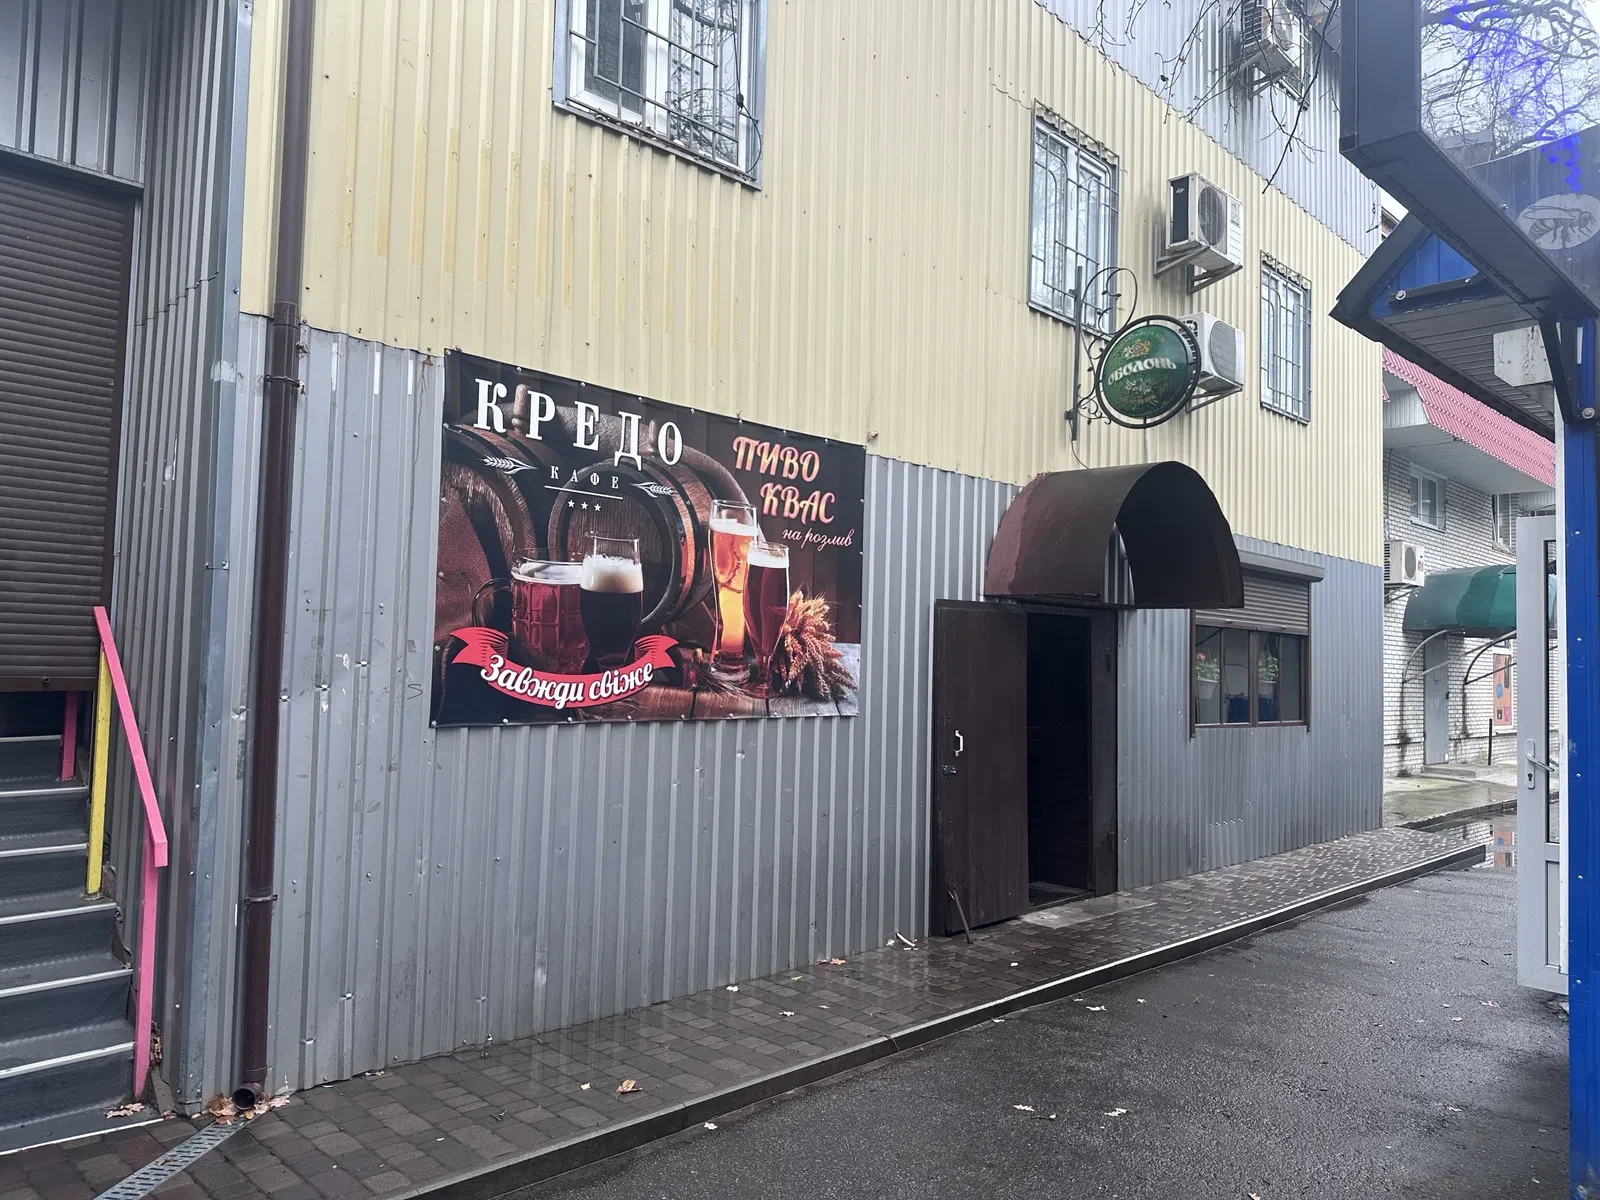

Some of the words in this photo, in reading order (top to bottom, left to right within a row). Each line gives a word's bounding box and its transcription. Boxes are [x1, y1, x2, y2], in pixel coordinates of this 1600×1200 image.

[1107, 357, 1177, 386] ОБОЛОНЬ
[473, 378, 684, 471] КРЕДО
[550, 465, 619, 489] КАФЕ
[732, 436, 820, 482] ПИВО
[760, 482, 836, 525] КВАС
[782, 528, 802, 541] на
[801, 528, 855, 552] розлив
[480, 654, 584, 710] Завжди
[588, 662, 654, 700] свіже
